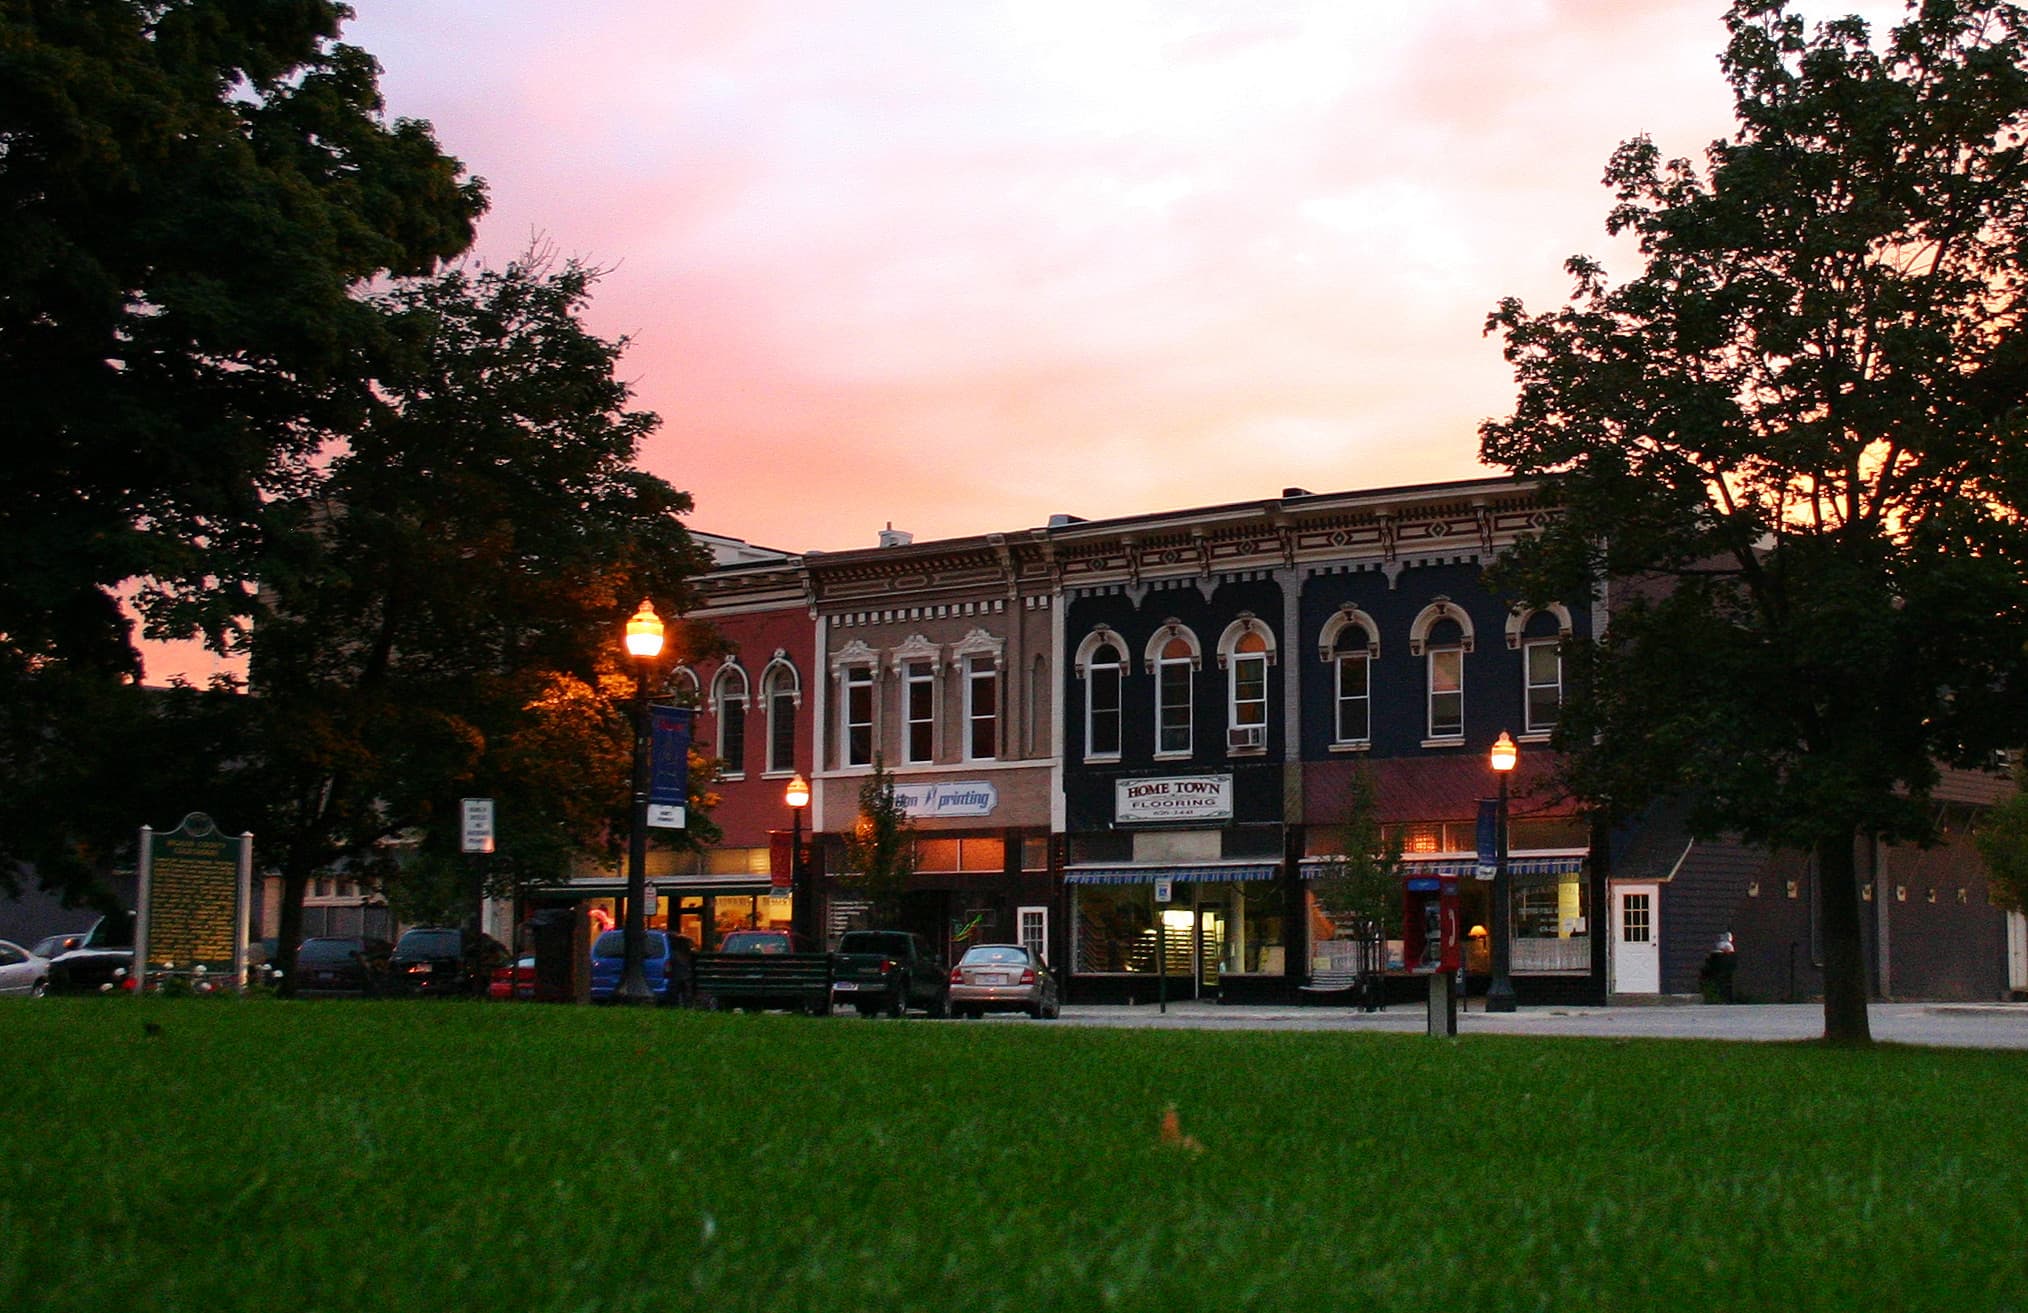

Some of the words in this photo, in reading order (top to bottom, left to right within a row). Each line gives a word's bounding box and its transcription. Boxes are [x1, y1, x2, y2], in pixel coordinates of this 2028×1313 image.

[1128, 783, 1170, 798] HOME
[1174, 781, 1221, 795] TOWN
[937, 790, 990, 810] printing
[1132, 798, 1216, 809] FLOORING
